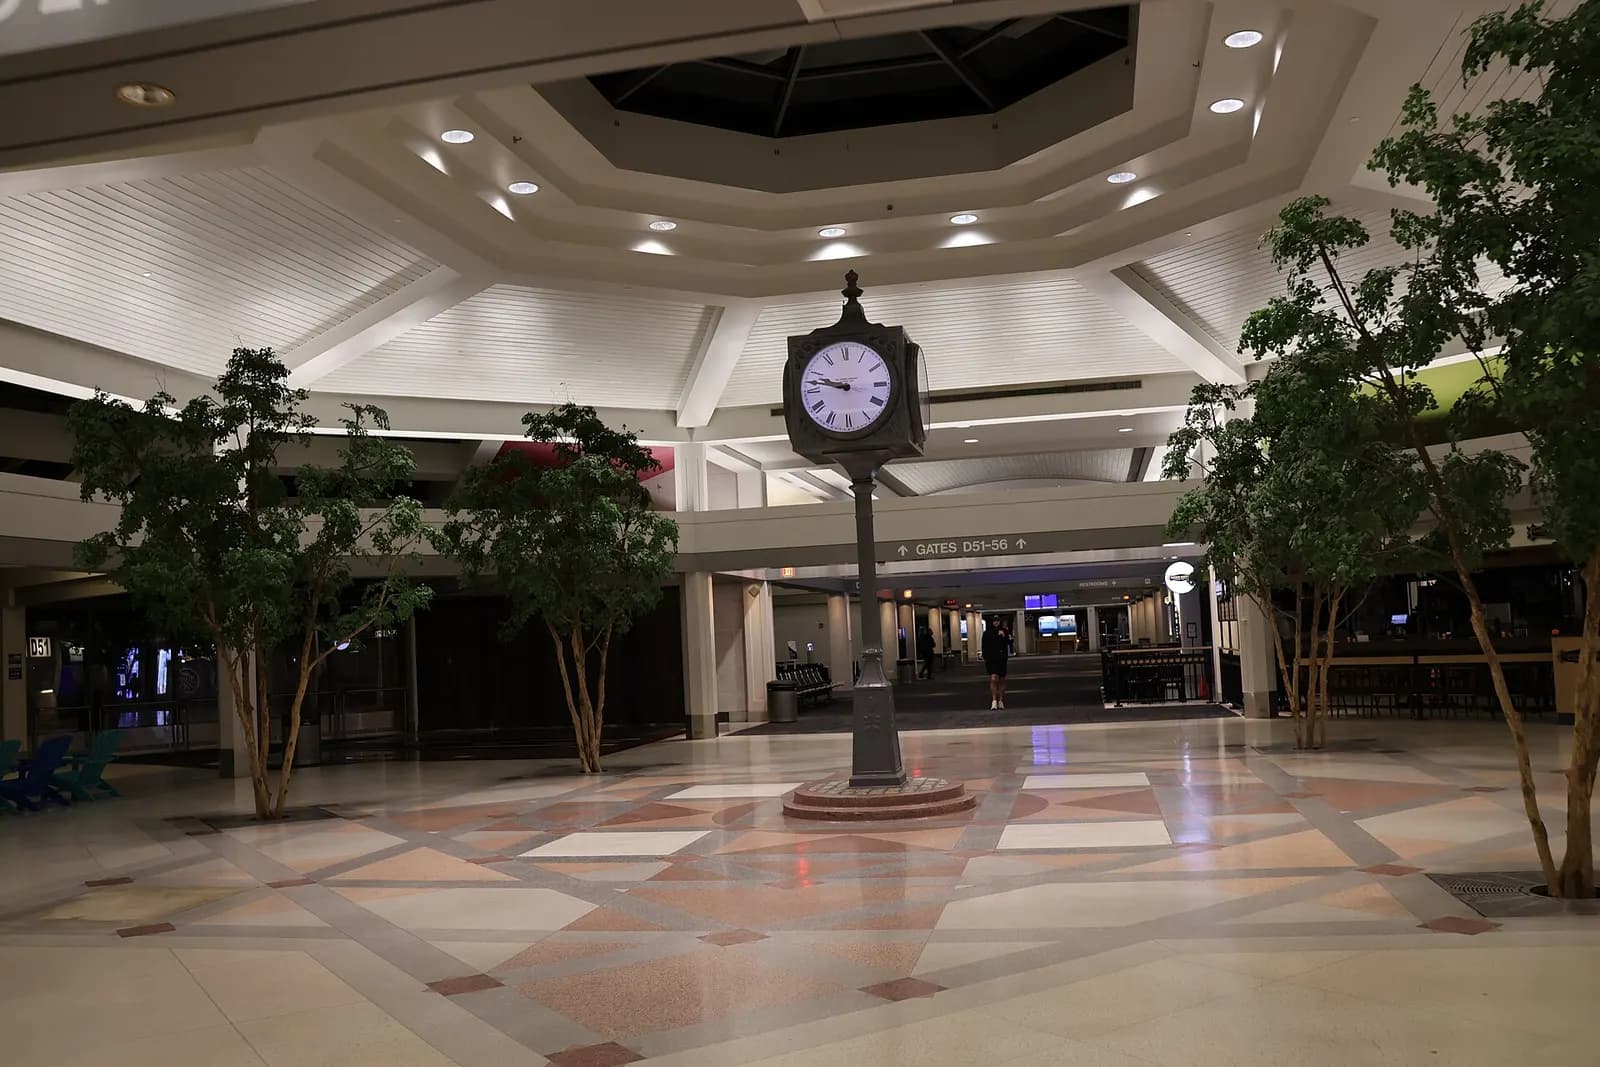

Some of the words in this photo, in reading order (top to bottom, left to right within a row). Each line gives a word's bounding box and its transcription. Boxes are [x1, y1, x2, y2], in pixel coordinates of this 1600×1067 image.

[915, 541, 957, 555] GATES
[962, 539, 1008, 552] D51-56
[31, 638, 49, 656] D51
